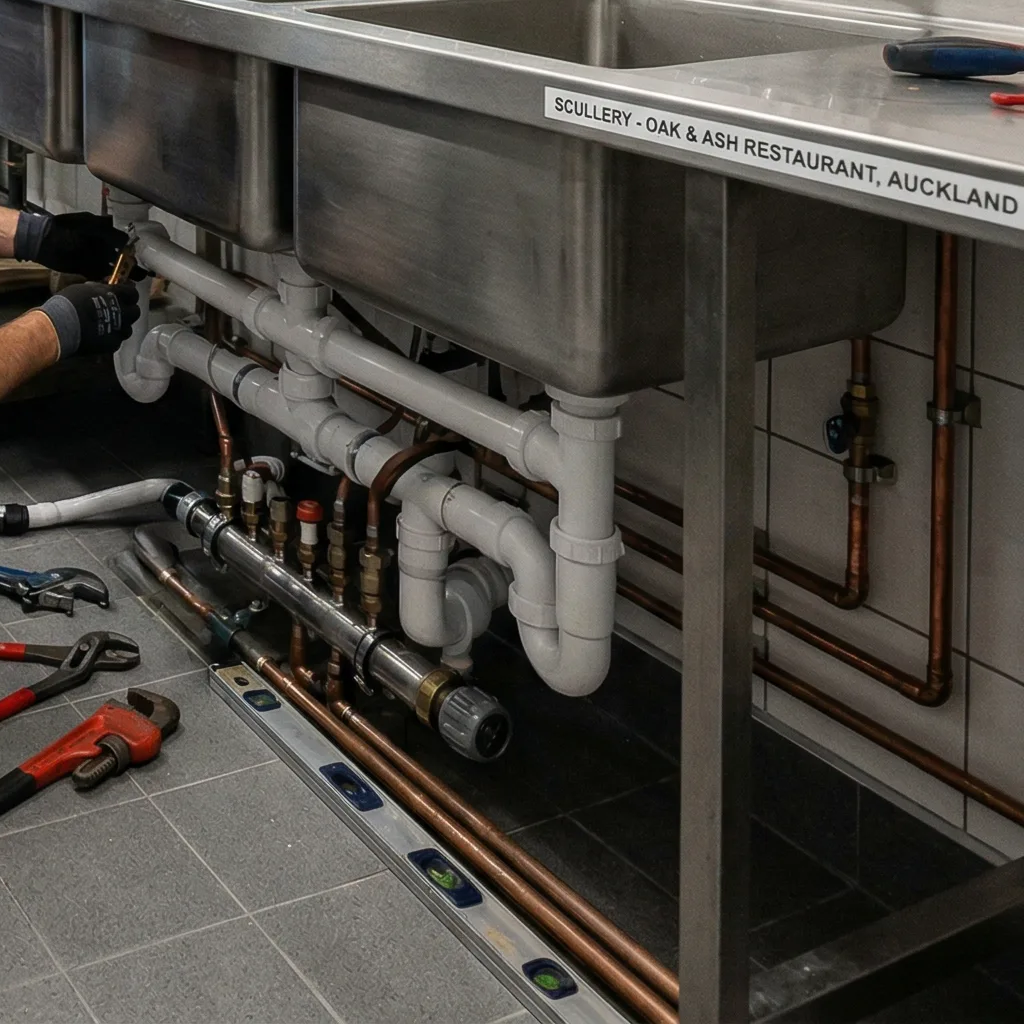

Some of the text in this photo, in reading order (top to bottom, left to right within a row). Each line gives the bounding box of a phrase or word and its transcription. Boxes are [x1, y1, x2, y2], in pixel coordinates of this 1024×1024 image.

[554, 97, 632, 127] SCULLERY
[646, 117, 681, 139] OAK
[686, 125, 697, 142] &
[702, 130, 738, 152] ASH
[744, 138, 881, 188] RESTAURANT,
[887, 171, 1018, 215] AUCKLAND
